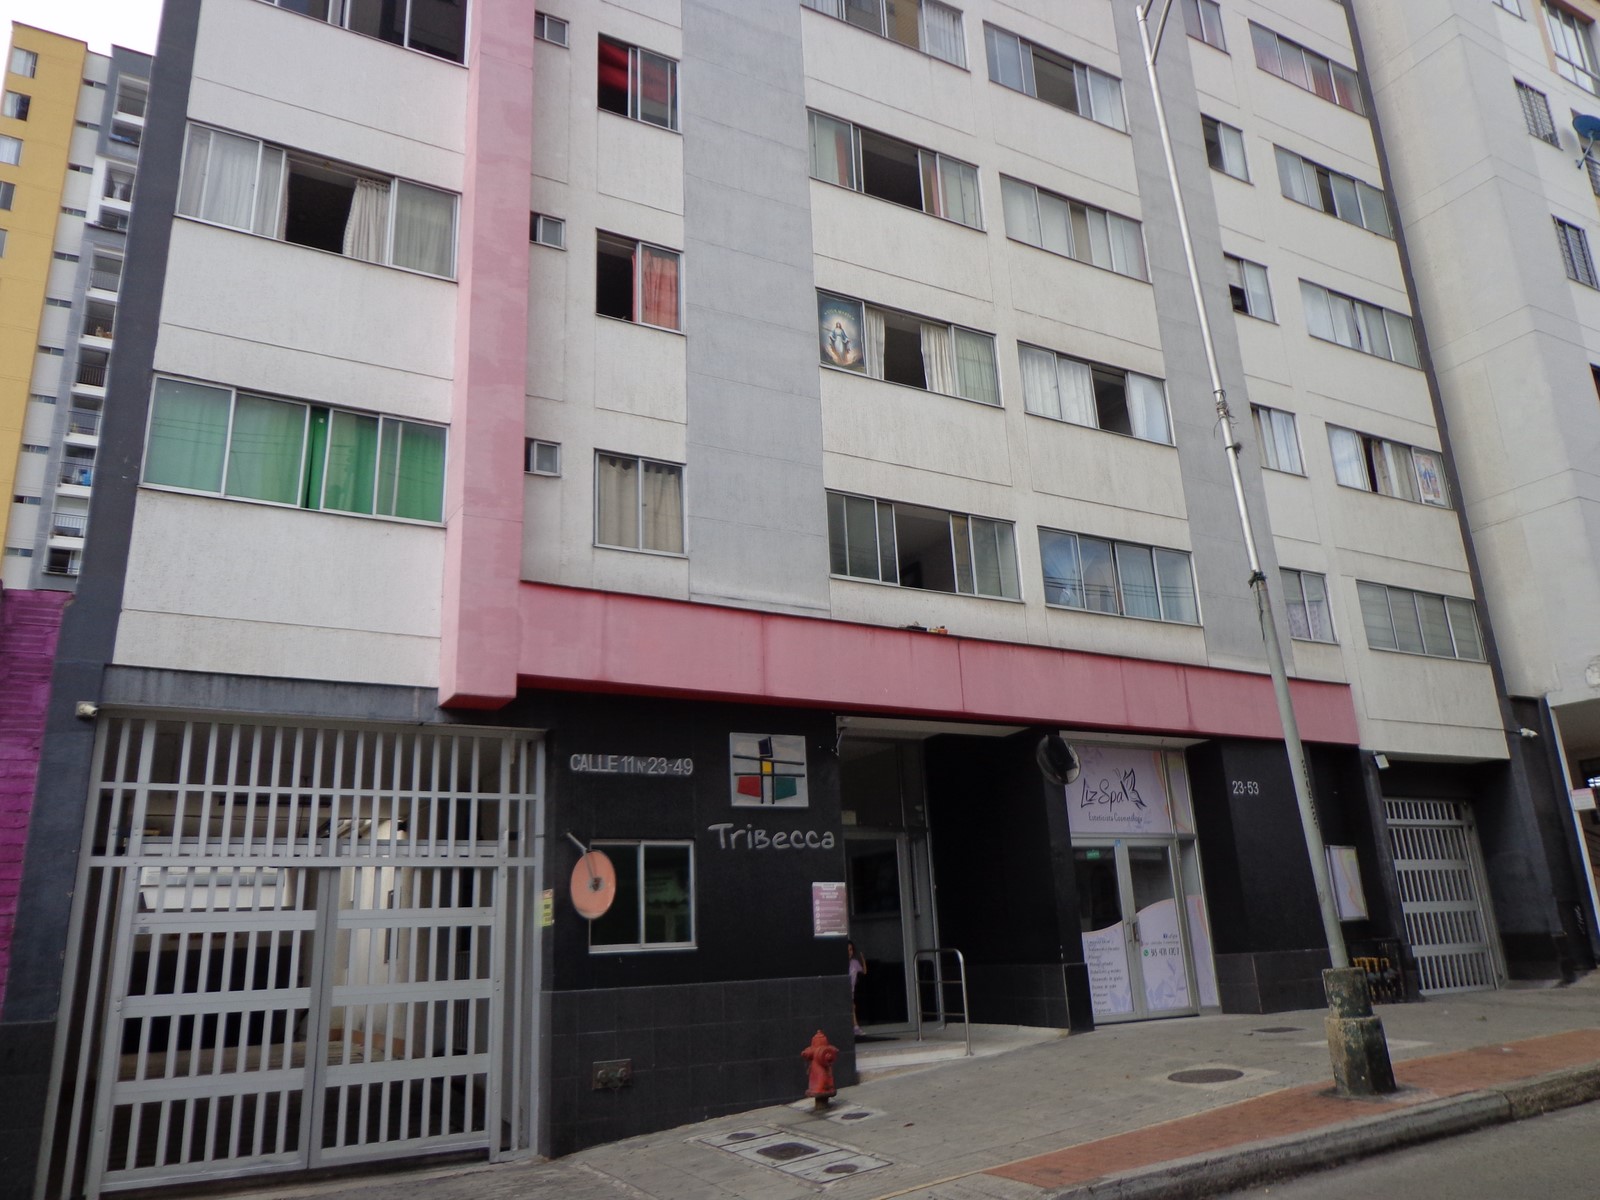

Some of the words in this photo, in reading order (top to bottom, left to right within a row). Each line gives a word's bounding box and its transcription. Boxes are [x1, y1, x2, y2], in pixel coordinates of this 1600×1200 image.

[570, 754, 618, 772] CALLE
[621, 756, 635, 773] 11
[648, 757, 694, 775] 23-49
[1098, 778, 1124, 812] Spa
